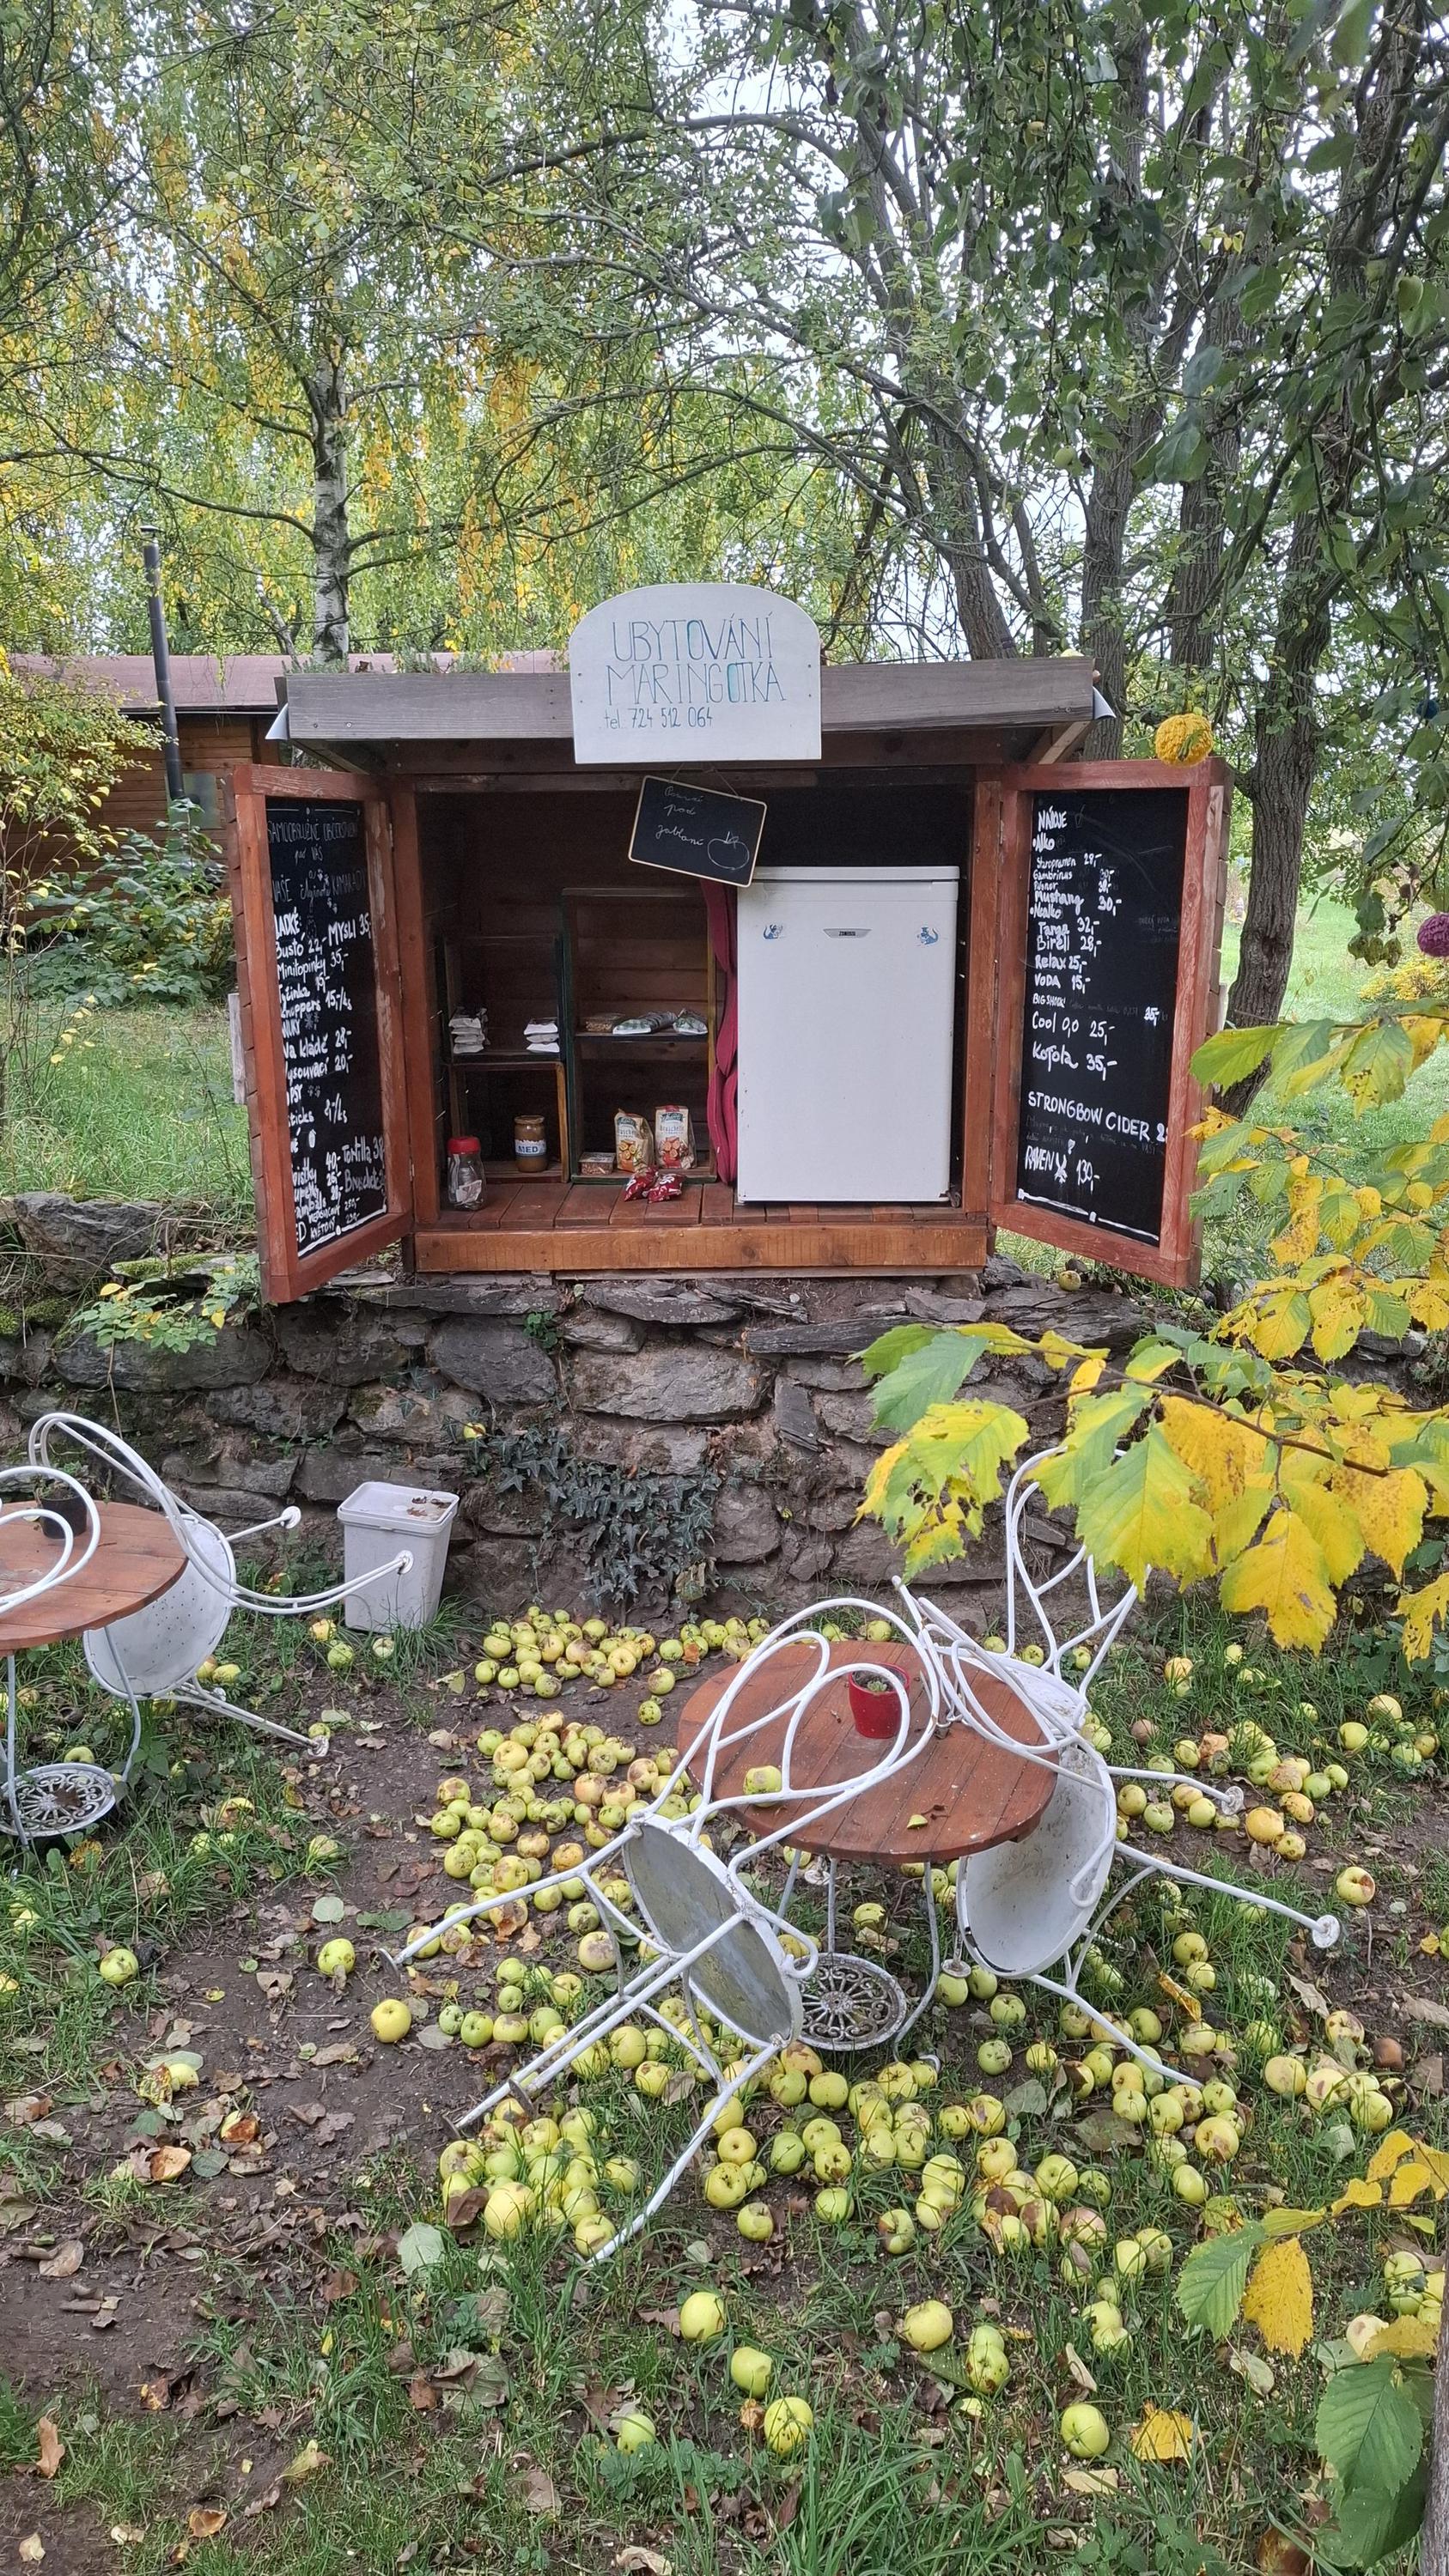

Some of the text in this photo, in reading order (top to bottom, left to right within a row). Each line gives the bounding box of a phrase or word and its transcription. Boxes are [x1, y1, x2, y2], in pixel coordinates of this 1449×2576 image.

[612, 611, 773, 661] UBYTOVÁNÍ
[606, 661, 787, 705] MARINGOTKA
[628, 707, 653, 729] 724
[661, 707, 681, 728] 512
[688, 706, 713, 728] 064
[1033, 870, 1073, 882] Gambrinus
[1034, 890, 1122, 916] Mustang 30,-
[274, 906, 301, 940] LADKÉ:
[1077, 916, 1100, 935] 32,-
[1037, 934, 1102, 957] Birell 28,-
[330, 948, 349, 971] 35,-
[1035, 951, 1087, 973] Relax 25,-
[1071, 975, 1091, 994] 15,-
[1032, 993, 1045, 1005] BIG
[335, 1027, 351, 1049] 28,-
[1032, 1011, 1115, 1046] Cool 0,0 25,-
[335, 1054, 353, 1073] 20,-
[1032, 1041, 1117, 1081] Kofola 35,-
[1028, 1091, 1103, 1126] STRONGBOW
[1105, 1111, 1151, 1142] CIDER
[342, 1135, 371, 1163] Tortilla
[1076, 1158, 1100, 1194] 130,-
